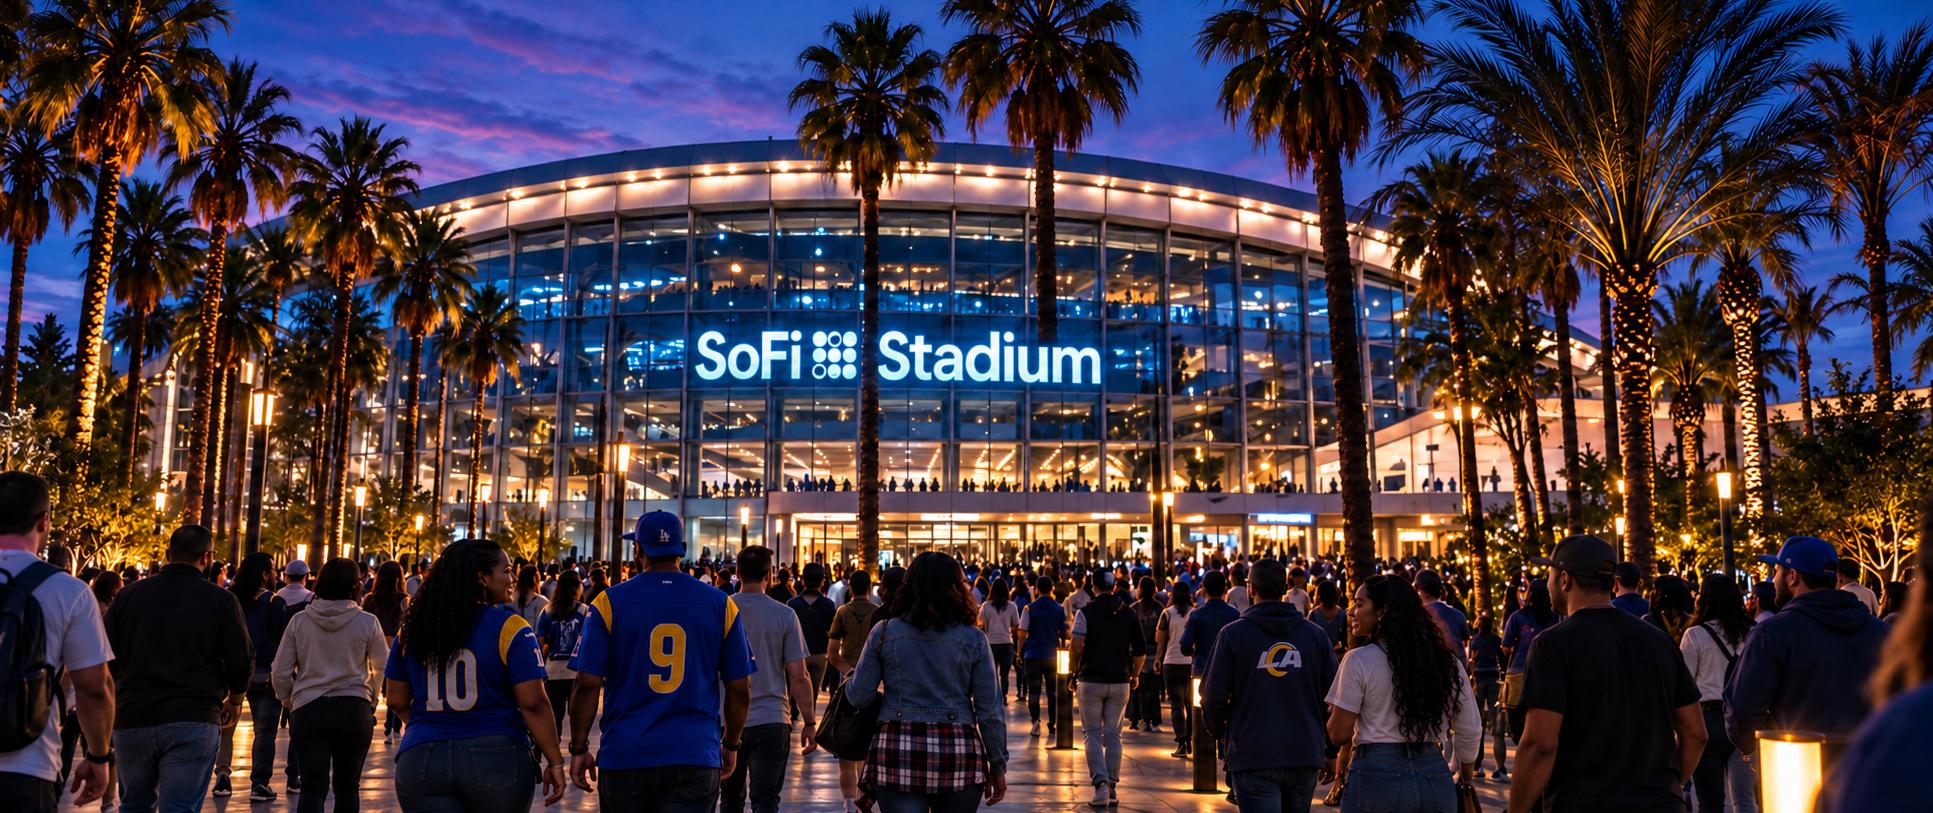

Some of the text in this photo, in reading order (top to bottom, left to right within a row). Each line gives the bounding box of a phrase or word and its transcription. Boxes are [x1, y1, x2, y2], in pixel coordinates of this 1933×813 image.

[695, 330, 1102, 385] SoFi Stadium
[425, 648, 479, 712] 10
[648, 623, 687, 694] 9
